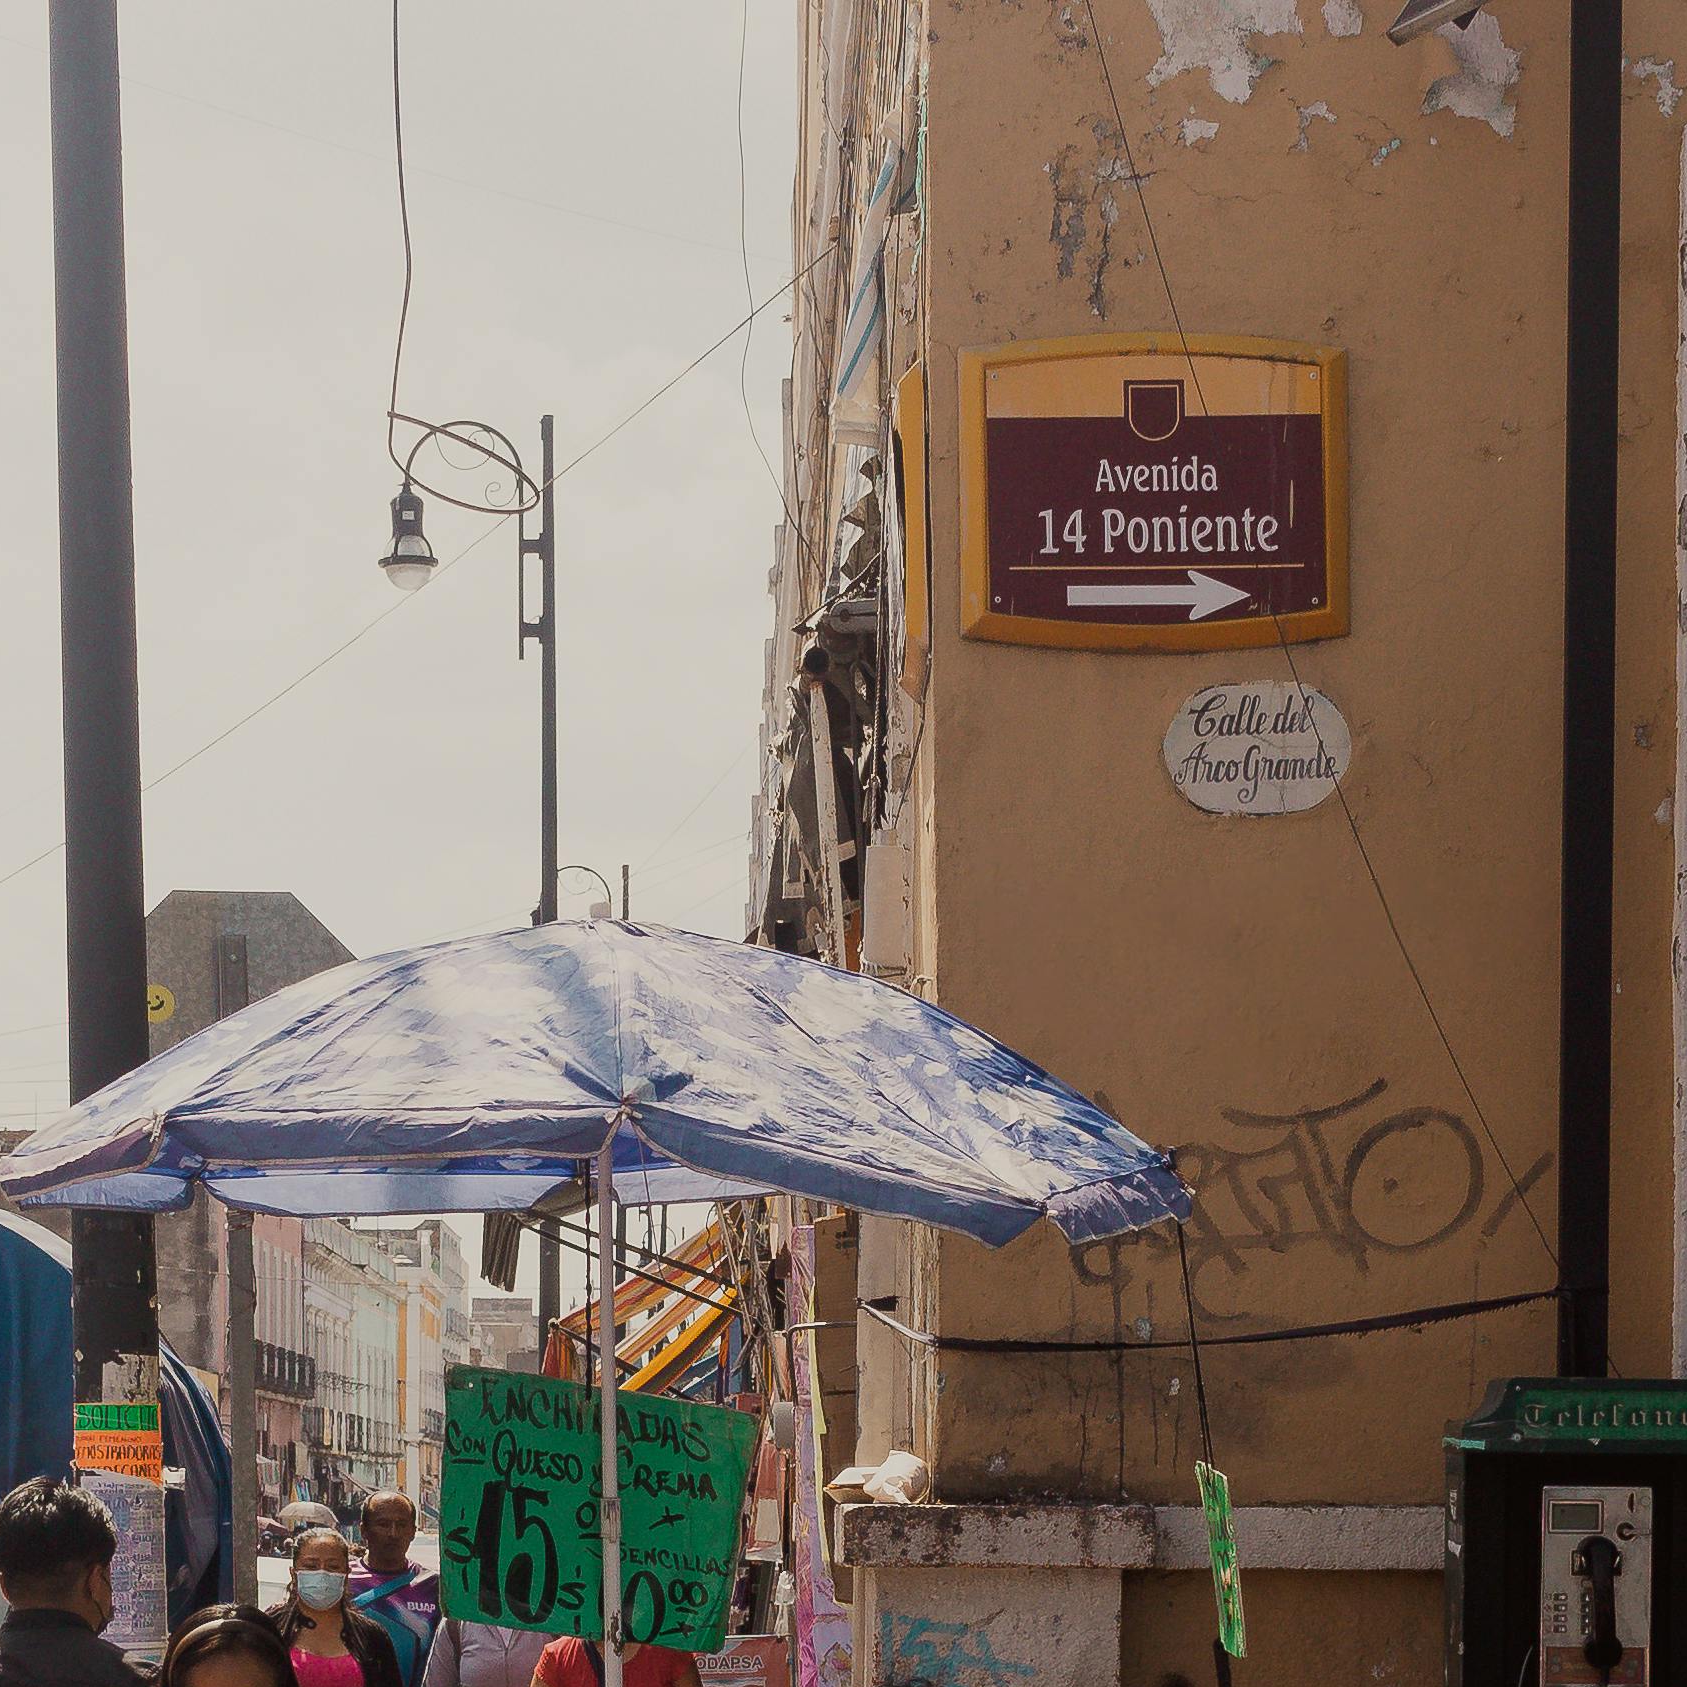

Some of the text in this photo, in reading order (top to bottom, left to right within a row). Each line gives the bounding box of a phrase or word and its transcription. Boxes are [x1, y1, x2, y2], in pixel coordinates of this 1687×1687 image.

[1095, 455, 1219, 493] Avenida
[1038, 504, 1280, 555] 14 Poniente
[1188, 694, 1314, 738] Calle del
[1174, 741, 1340, 804] Arco Grande
[491, 1428, 584, 1492] QUESO
[406, 1601, 436, 1613] BUAP
